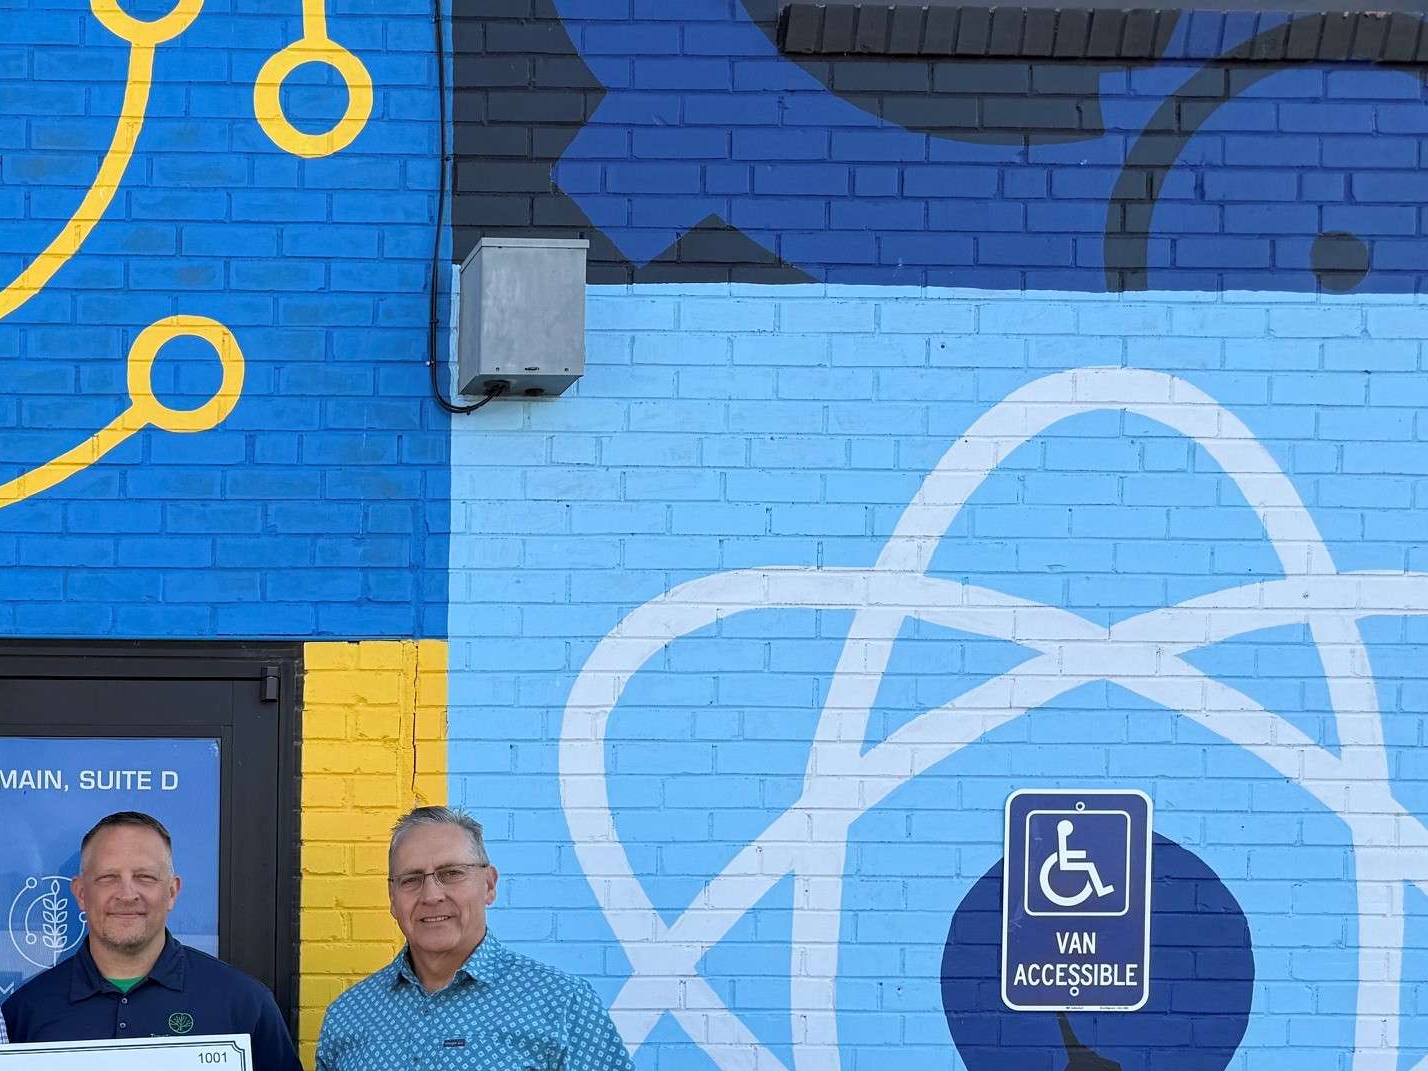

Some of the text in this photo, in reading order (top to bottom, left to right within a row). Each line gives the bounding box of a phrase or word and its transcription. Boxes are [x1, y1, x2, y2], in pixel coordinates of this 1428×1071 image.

[79, 770, 152, 791] SUITE
[161, 771, 179, 791] D
[1056, 932, 1096, 954] VAN
[1013, 963, 1138, 986] ACCESSIBLE
[199, 1052, 228, 1064] 1001
